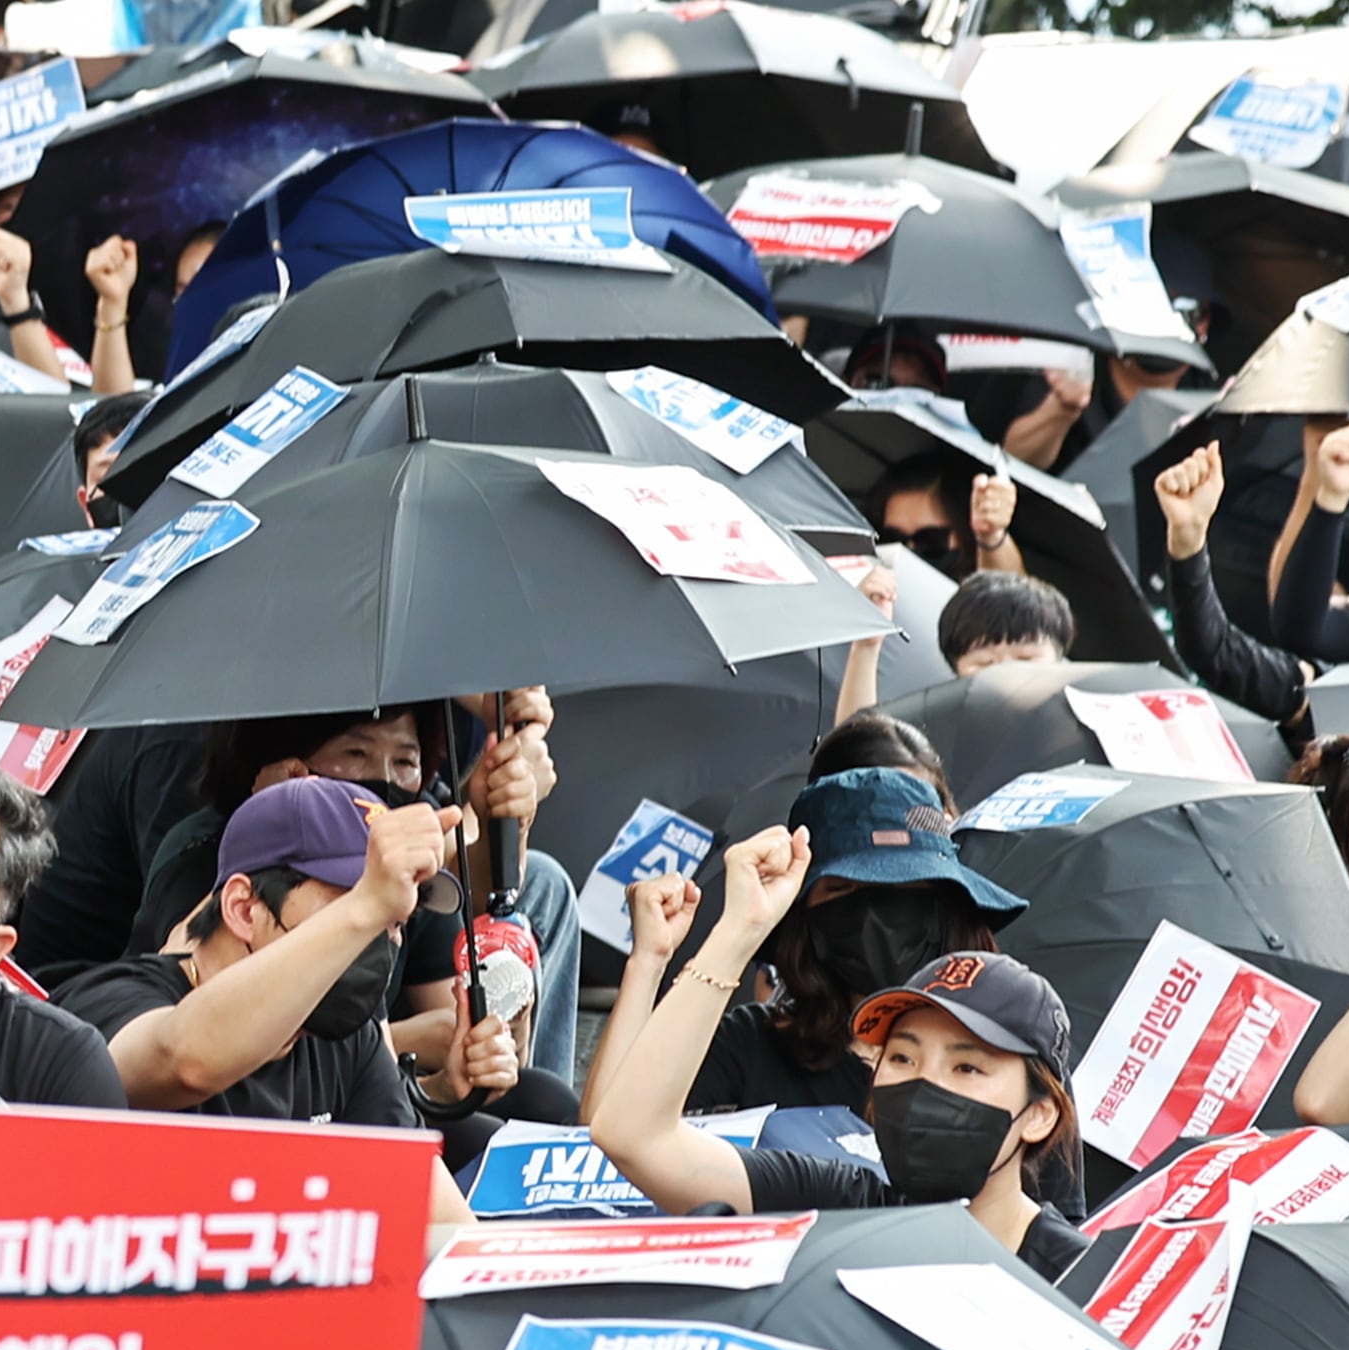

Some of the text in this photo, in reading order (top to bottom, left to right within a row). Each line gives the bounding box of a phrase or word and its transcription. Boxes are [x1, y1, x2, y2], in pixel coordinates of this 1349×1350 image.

[1090, 955, 1205, 1128] 계획범죄 희생양!
[1206, 993, 1282, 1102] 판매자!
[523, 1182, 577, 1207] 못한
